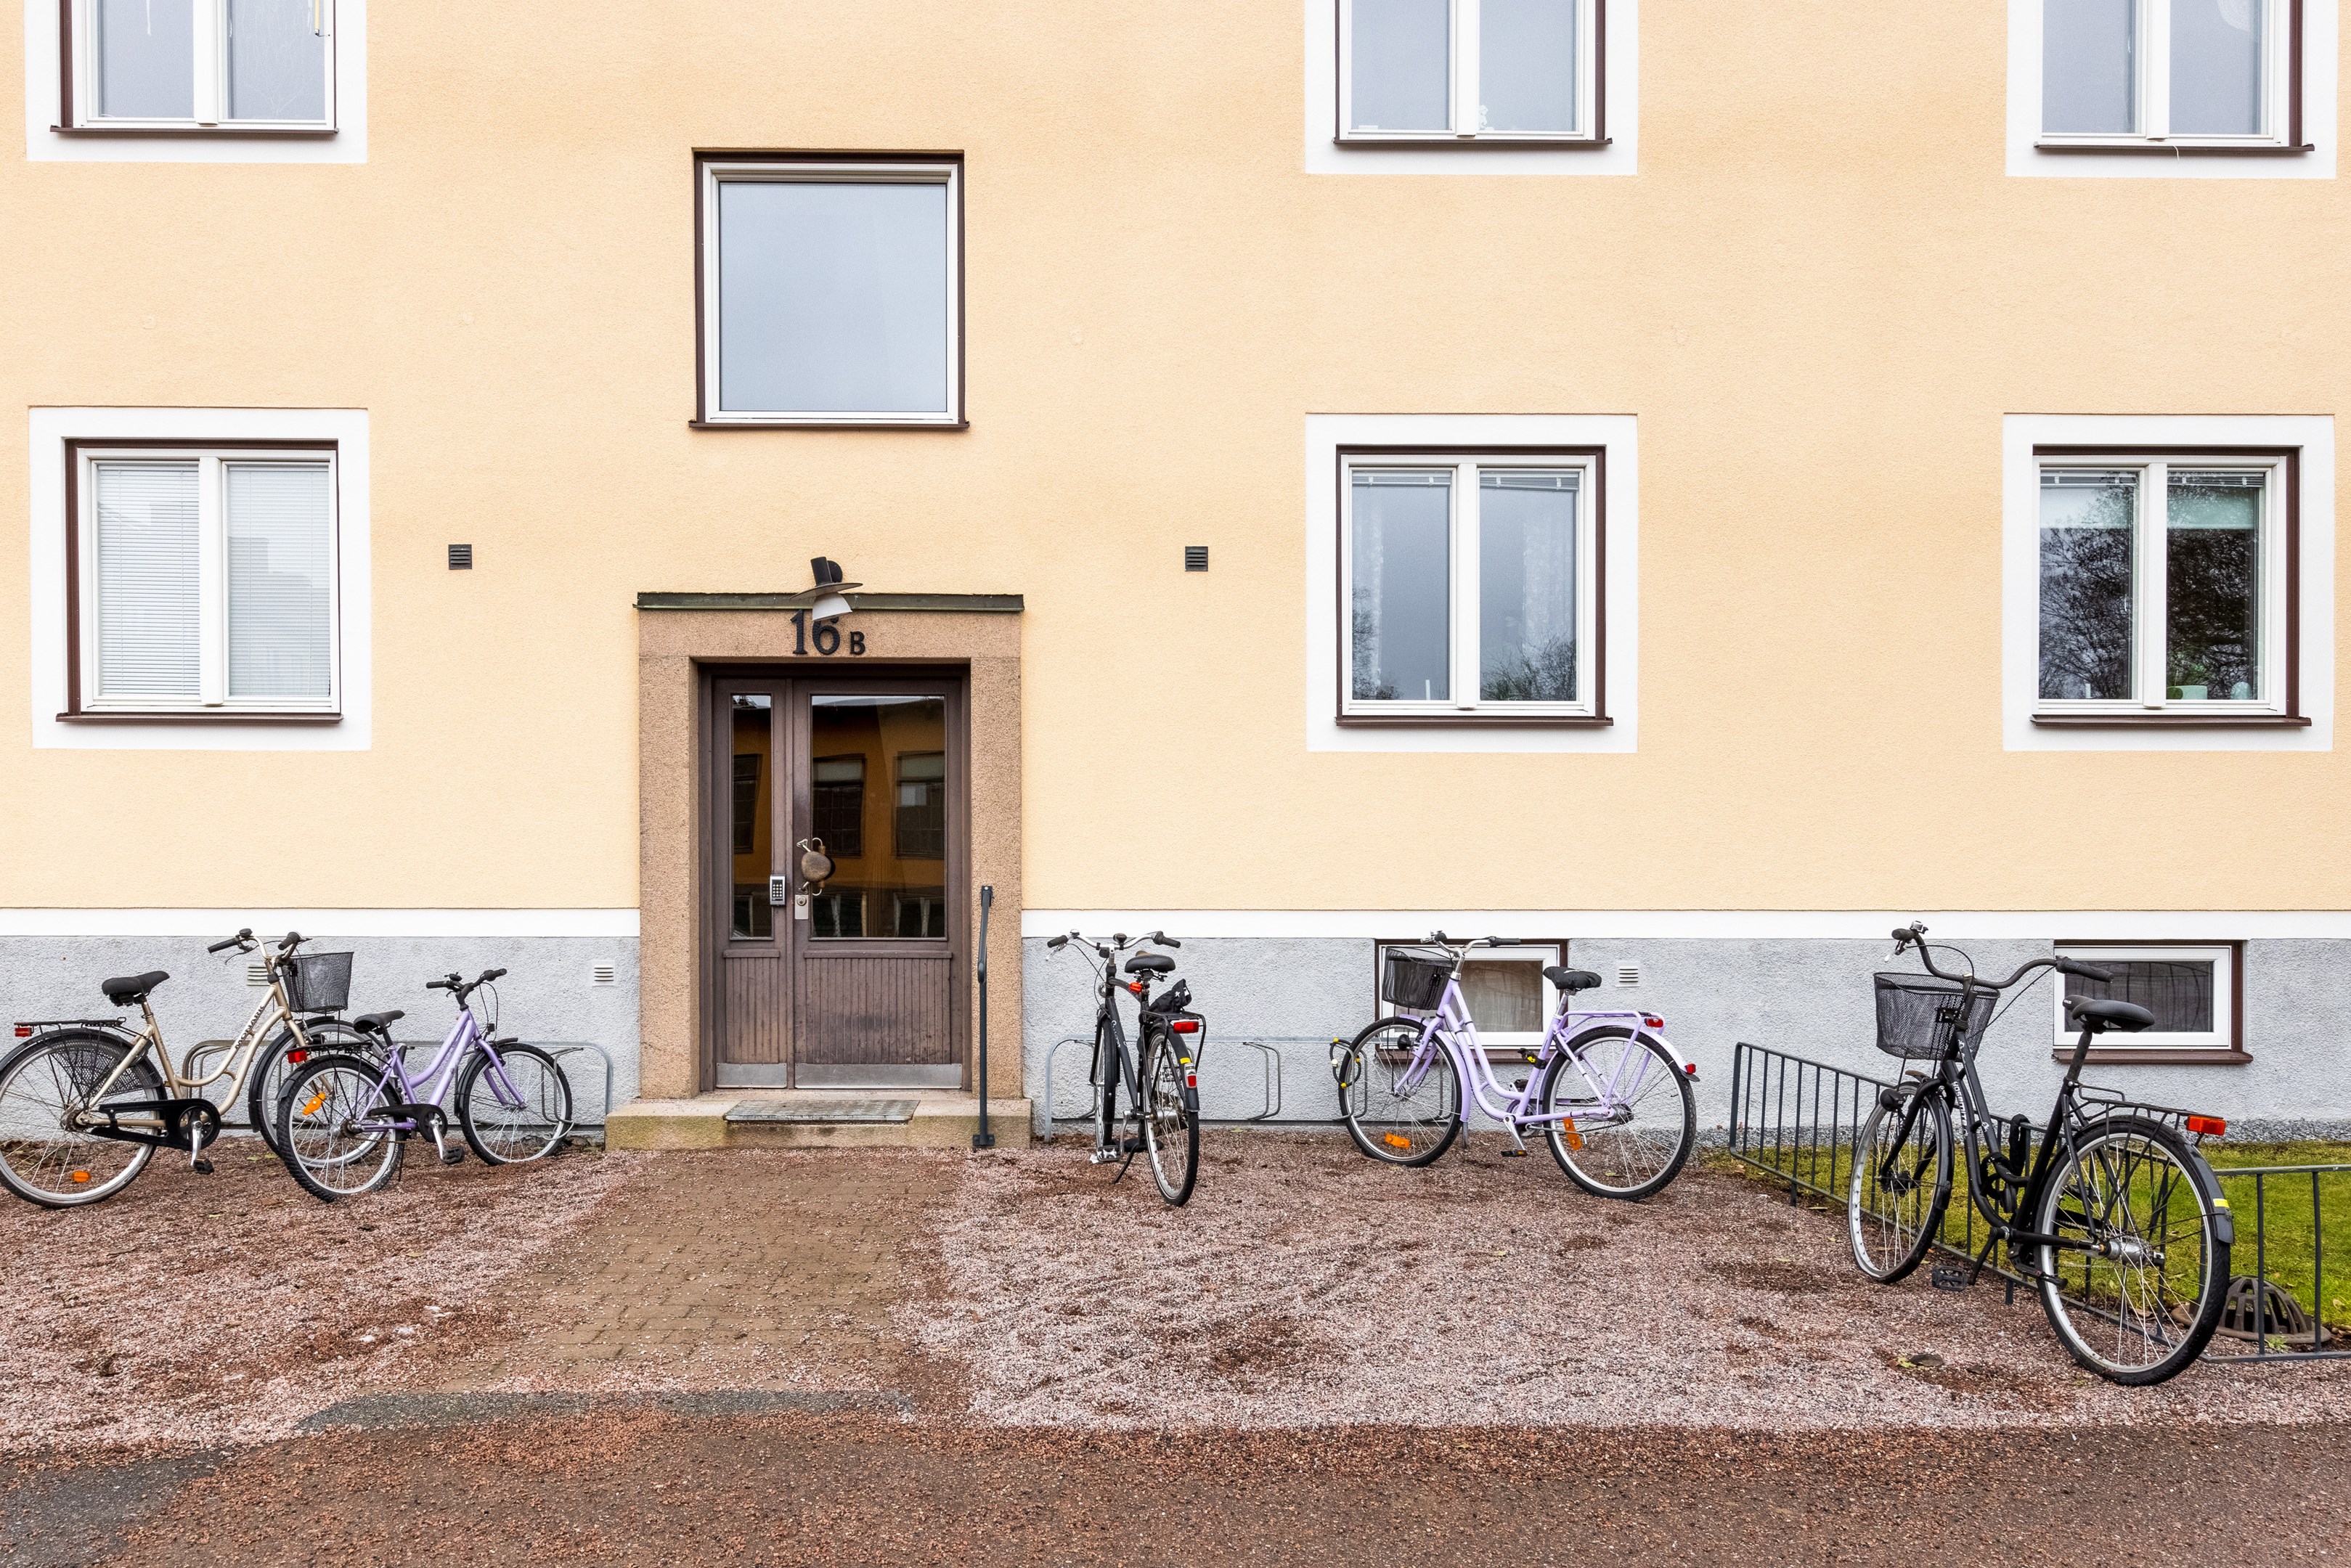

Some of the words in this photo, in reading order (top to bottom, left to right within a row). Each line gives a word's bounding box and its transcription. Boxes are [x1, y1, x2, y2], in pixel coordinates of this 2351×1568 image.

[790, 608, 841, 656] 16
[849, 631, 866, 656] B
[235, 1005, 265, 1050] MONARK
